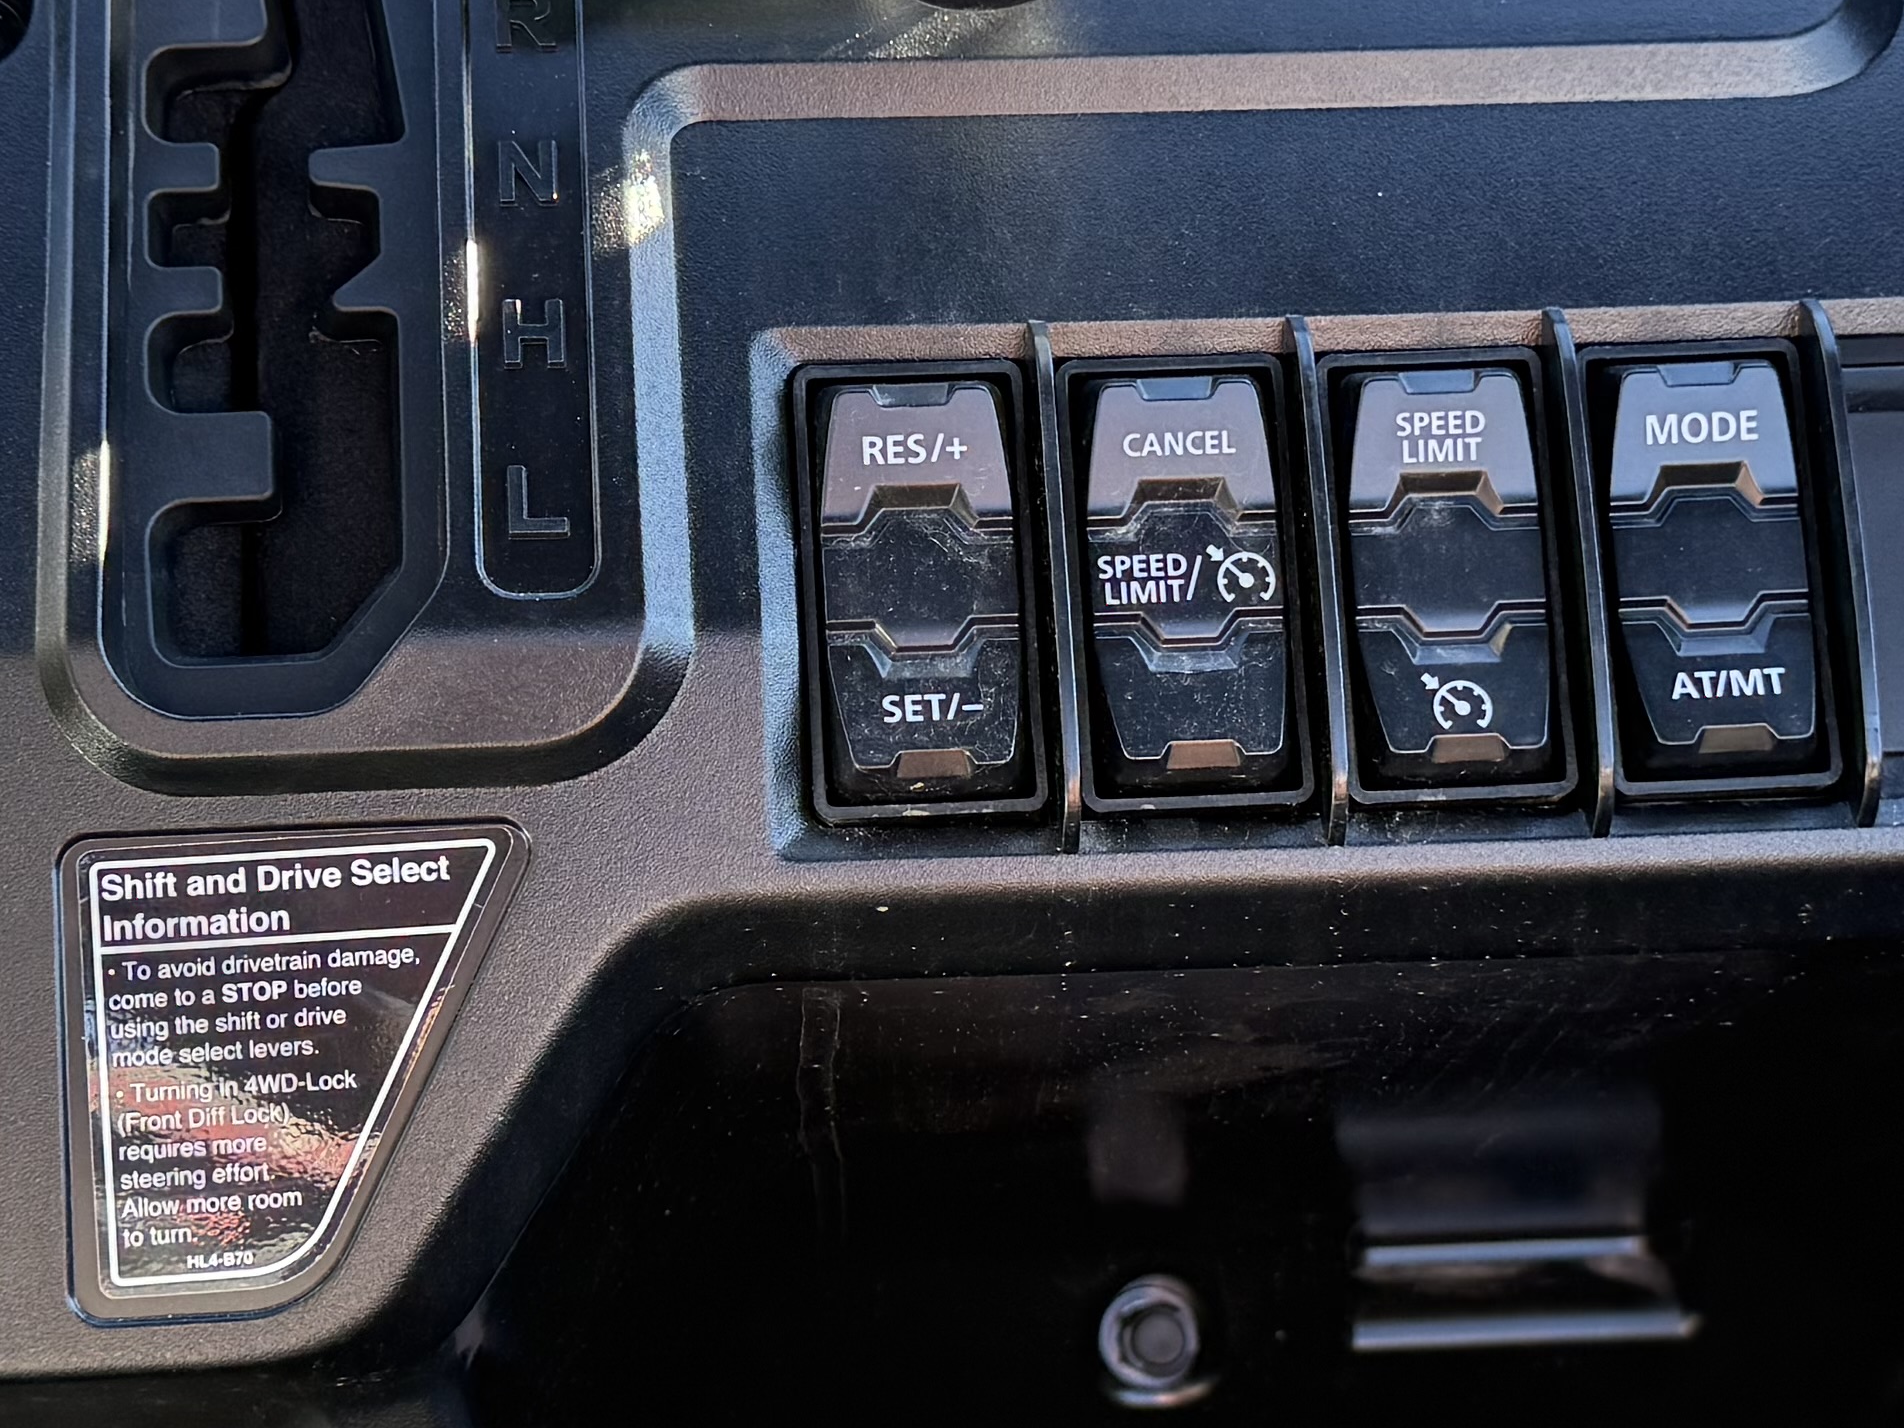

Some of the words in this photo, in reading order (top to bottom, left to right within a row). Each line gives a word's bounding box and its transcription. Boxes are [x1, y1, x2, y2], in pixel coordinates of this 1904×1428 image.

[498, 140, 558, 206] N
[503, 297, 567, 369] H
[1395, 409, 1486, 438] SPEED
[1644, 409, 1759, 447] MODE
[861, 433, 969, 469] RES/+
[1121, 428, 1236, 460] CANCEL
[1402, 436, 1482, 464] LIMIT
[508, 464, 570, 540] L
[1671, 666, 1783, 702] AT/MT
[101, 872, 177, 901] Shift
[186, 867, 246, 895] and
[257, 865, 341, 892] Drive
[351, 856, 450, 887] Select
[102, 908, 291, 941] Information
[122, 962, 151, 982] To
[158, 959, 216, 979] avoid
[222, 952, 321, 976] drivetrain
[328, 947, 421, 972] damage,
[109, 992, 167, 1010] come
[175, 989, 196, 1006] to
[201, 990, 215, 1005] a
[222, 981, 287, 1003] STOP
[294, 978, 362, 999] before
[110, 1020, 169, 1041] using
[175, 1016, 209, 1035] the
[215, 1014, 260, 1033] shift
[266, 1013, 288, 1029] or
[294, 1009, 346, 1027] drive
[112, 1046, 173, 1068] mode
[178, 1044, 242, 1063] select
[248, 1039, 319, 1060] levers.
[130, 1083, 213, 1104] Turning
[219, 1080, 238, 1099] in
[244, 1071, 357, 1094] 4WD-Lock
[117, 1113, 182, 1137] (Front
[188, 1109, 226, 1130] Diff
[231, 1103, 291, 1127] Lock)
[118, 1140, 207, 1162] requires
[212, 1136, 266, 1155] more
[120, 1167, 205, 1190] steering
[122, 1197, 180, 1219] Allow
[186, 1194, 241, 1215] more
[247, 1190, 303, 1209] room
[123, 1228, 144, 1247] to
[150, 1225, 198, 1245] turn.
